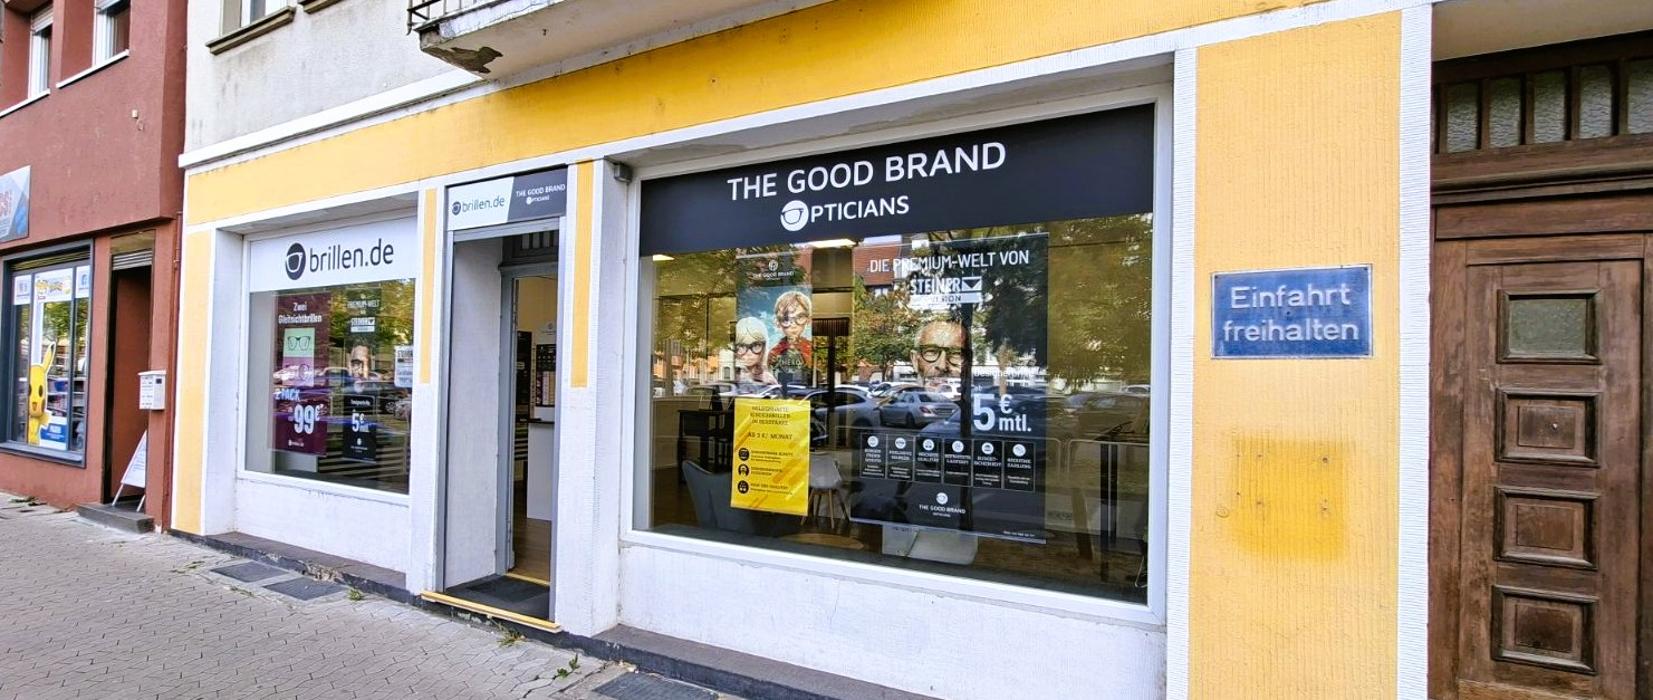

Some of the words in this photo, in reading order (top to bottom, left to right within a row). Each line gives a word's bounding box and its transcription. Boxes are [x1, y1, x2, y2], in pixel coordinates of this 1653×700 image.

[727, 173, 777, 200] THE
[787, 160, 874, 194] GOOD
[885, 141, 1007, 182] BRAND
[527, 186, 544, 196] GOOD
[545, 183, 566, 193] BRAND
[462, 195, 505, 213] brillen.de
[309, 238, 394, 273] brillen.de
[869, 259, 890, 273] DIE
[893, 252, 996, 272] PREMIUM-WELT
[1000, 250, 1029, 265] VON
[910, 277, 961, 295] STEINER
[1230, 283, 1351, 309] Einfahrt
[293, 301, 308, 311] Zwei
[1223, 318, 1360, 342] freihalten
[973, 393, 996, 431] 5
[999, 394, 1013, 414] €
[998, 414, 1032, 432] mtl.
